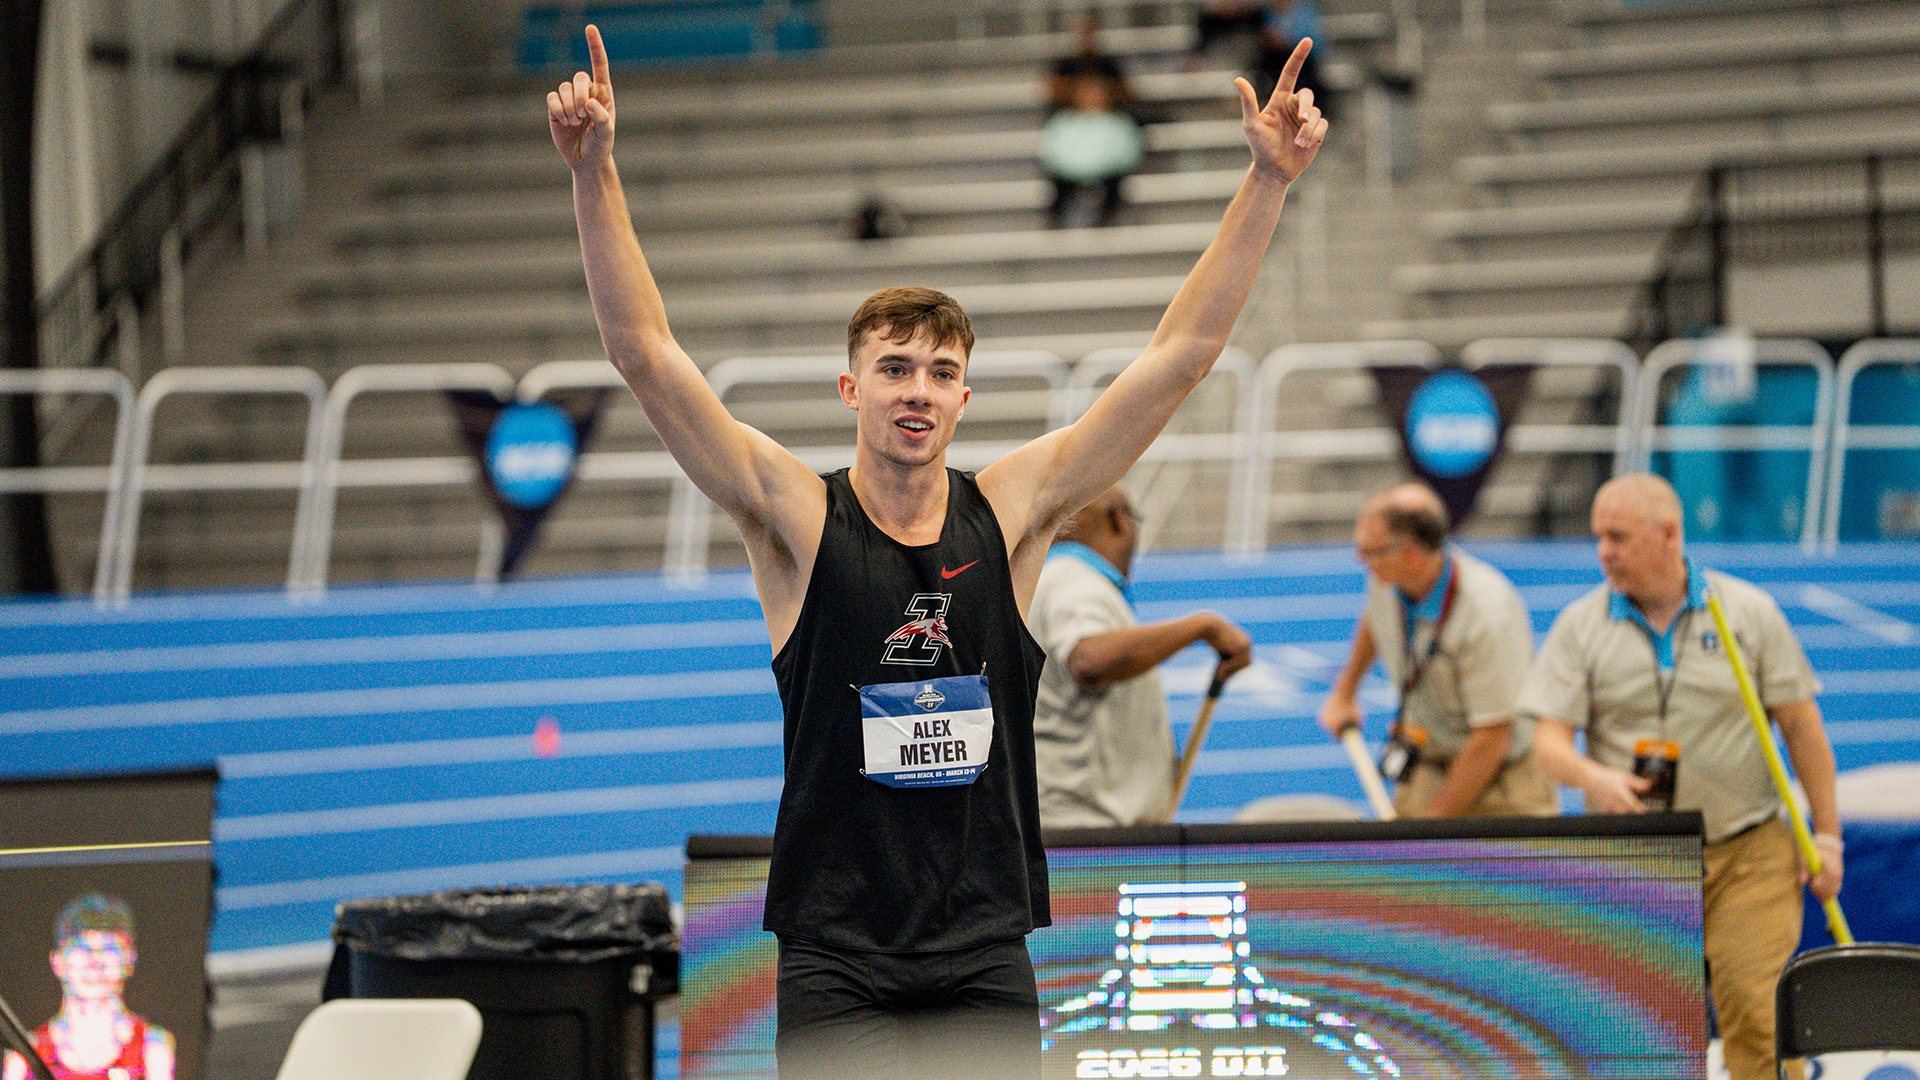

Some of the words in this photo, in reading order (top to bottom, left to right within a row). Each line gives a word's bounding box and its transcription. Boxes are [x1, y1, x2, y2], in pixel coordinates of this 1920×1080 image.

[913, 719, 952, 739] ALEX
[900, 740, 968, 766] MEYER
[917, 771, 935, 779] BEACH,
